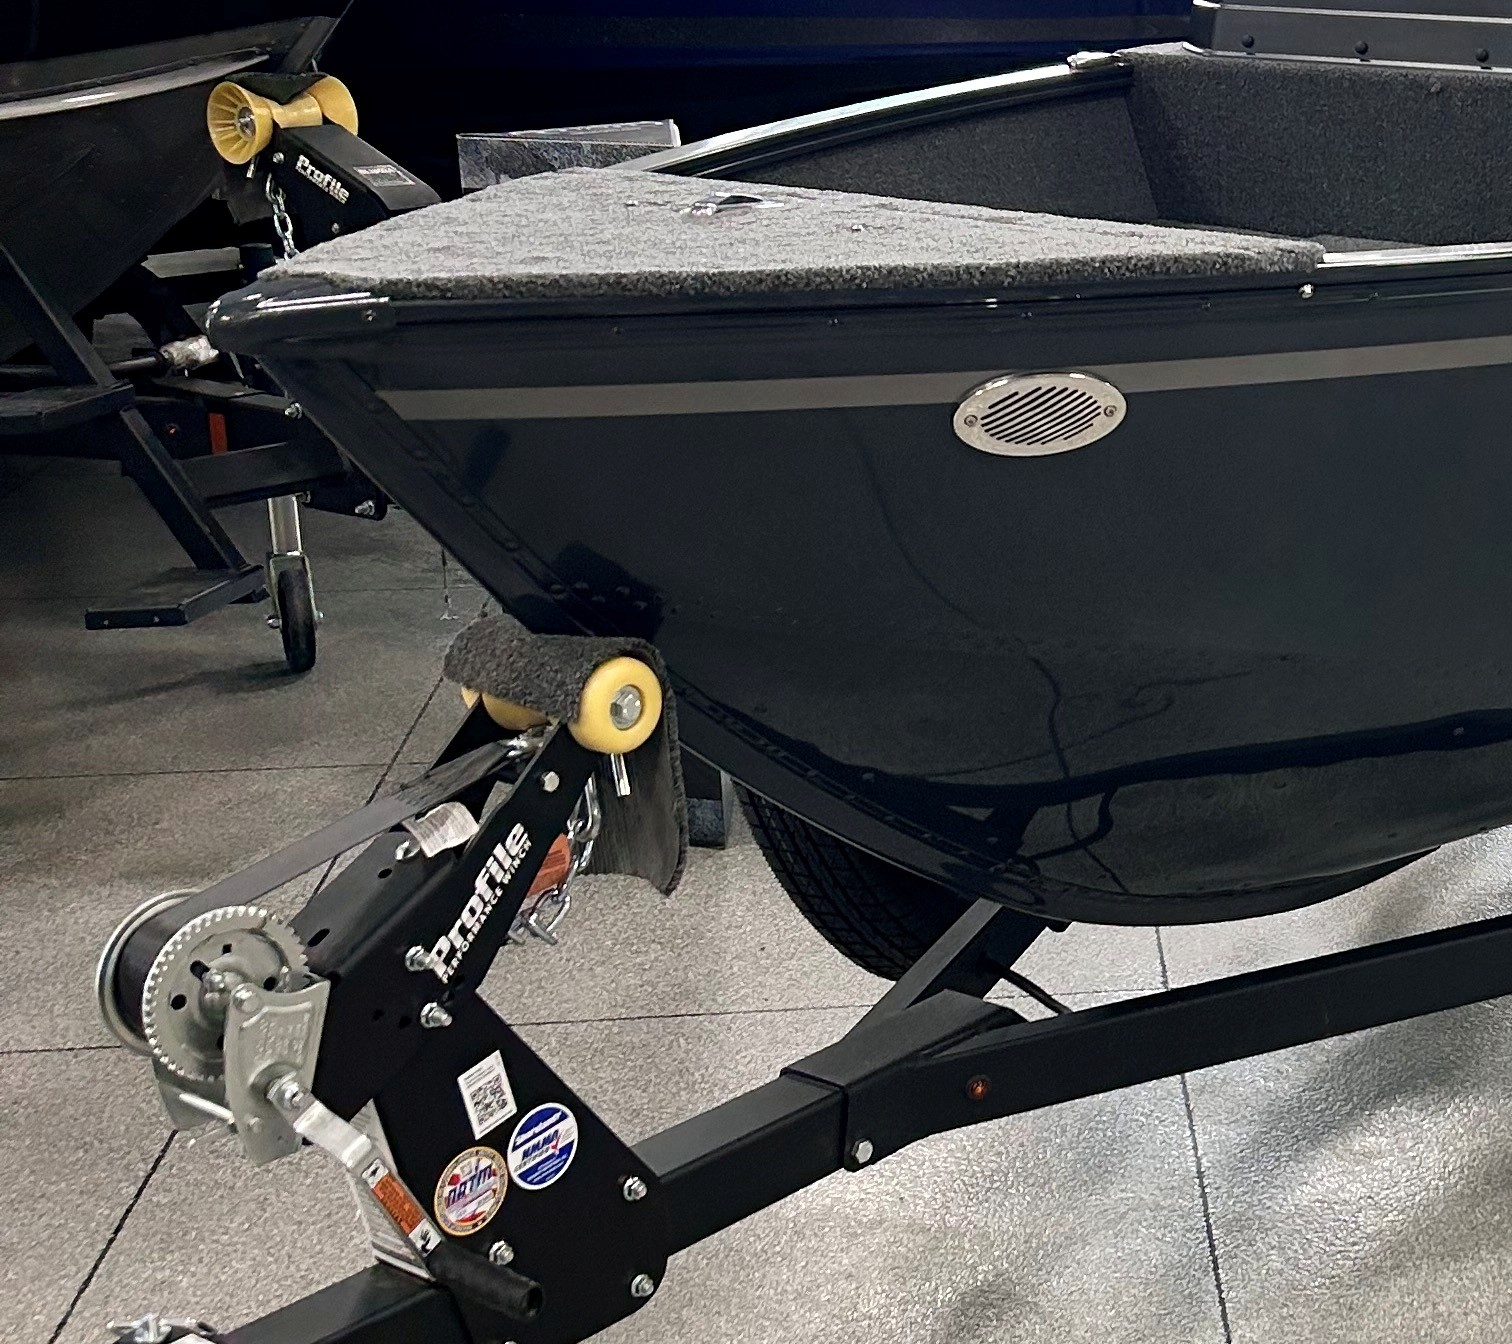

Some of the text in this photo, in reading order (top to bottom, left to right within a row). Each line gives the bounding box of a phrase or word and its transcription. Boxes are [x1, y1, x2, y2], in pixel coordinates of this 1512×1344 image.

[296, 154, 350, 199] Profile
[430, 822, 529, 980] Profile
[441, 885, 504, 984] PERFORMANCE
[501, 838, 532, 885] WINCH
